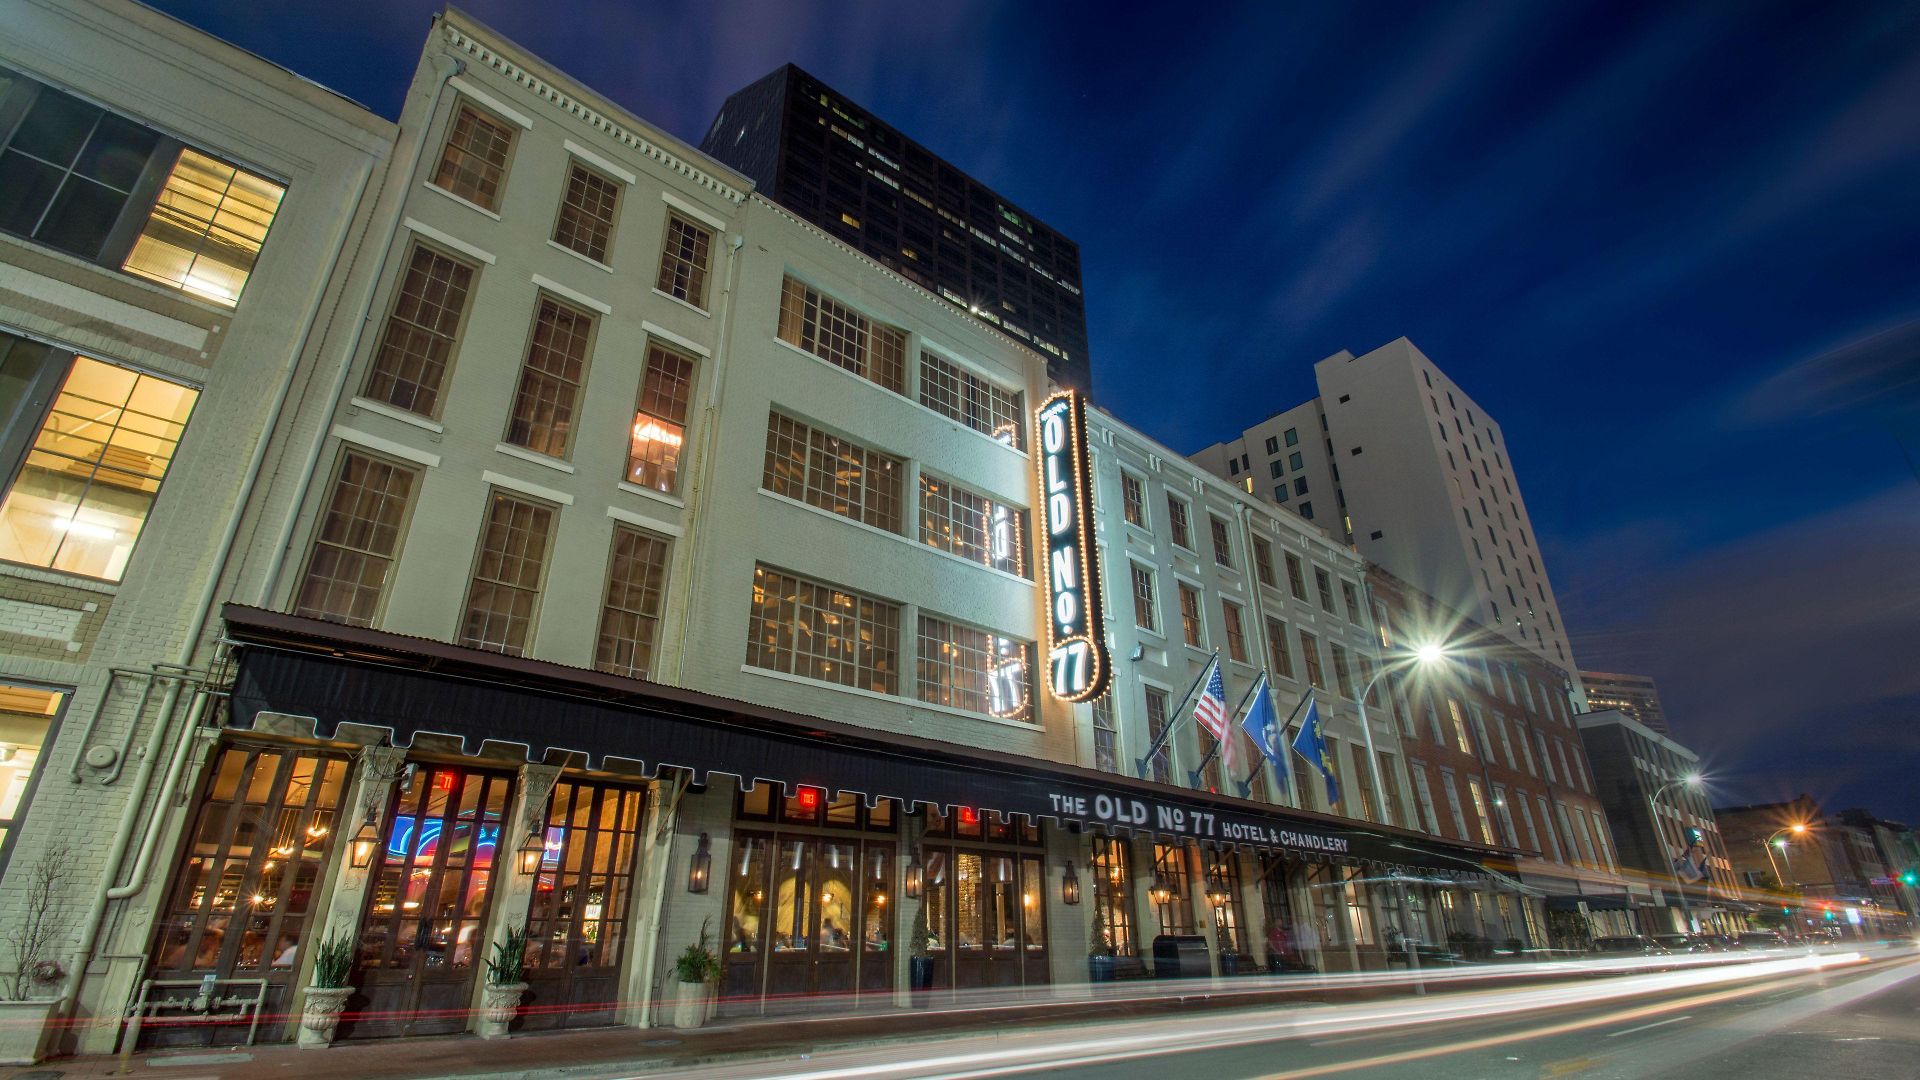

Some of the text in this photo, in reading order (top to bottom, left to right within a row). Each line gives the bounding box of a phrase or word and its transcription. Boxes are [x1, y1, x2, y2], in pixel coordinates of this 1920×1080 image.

[1044, 415, 1072, 535] OLD
[1052, 642, 1088, 695] 77
[1049, 793, 1087, 815] THE
[1095, 795, 1147, 824] OLD
[1190, 811, 1215, 836] 77
[1222, 822, 1267, 842] HOTEL
[1269, 828, 1278, 843] &
[1280, 830, 1348, 852] CHANDLERY
